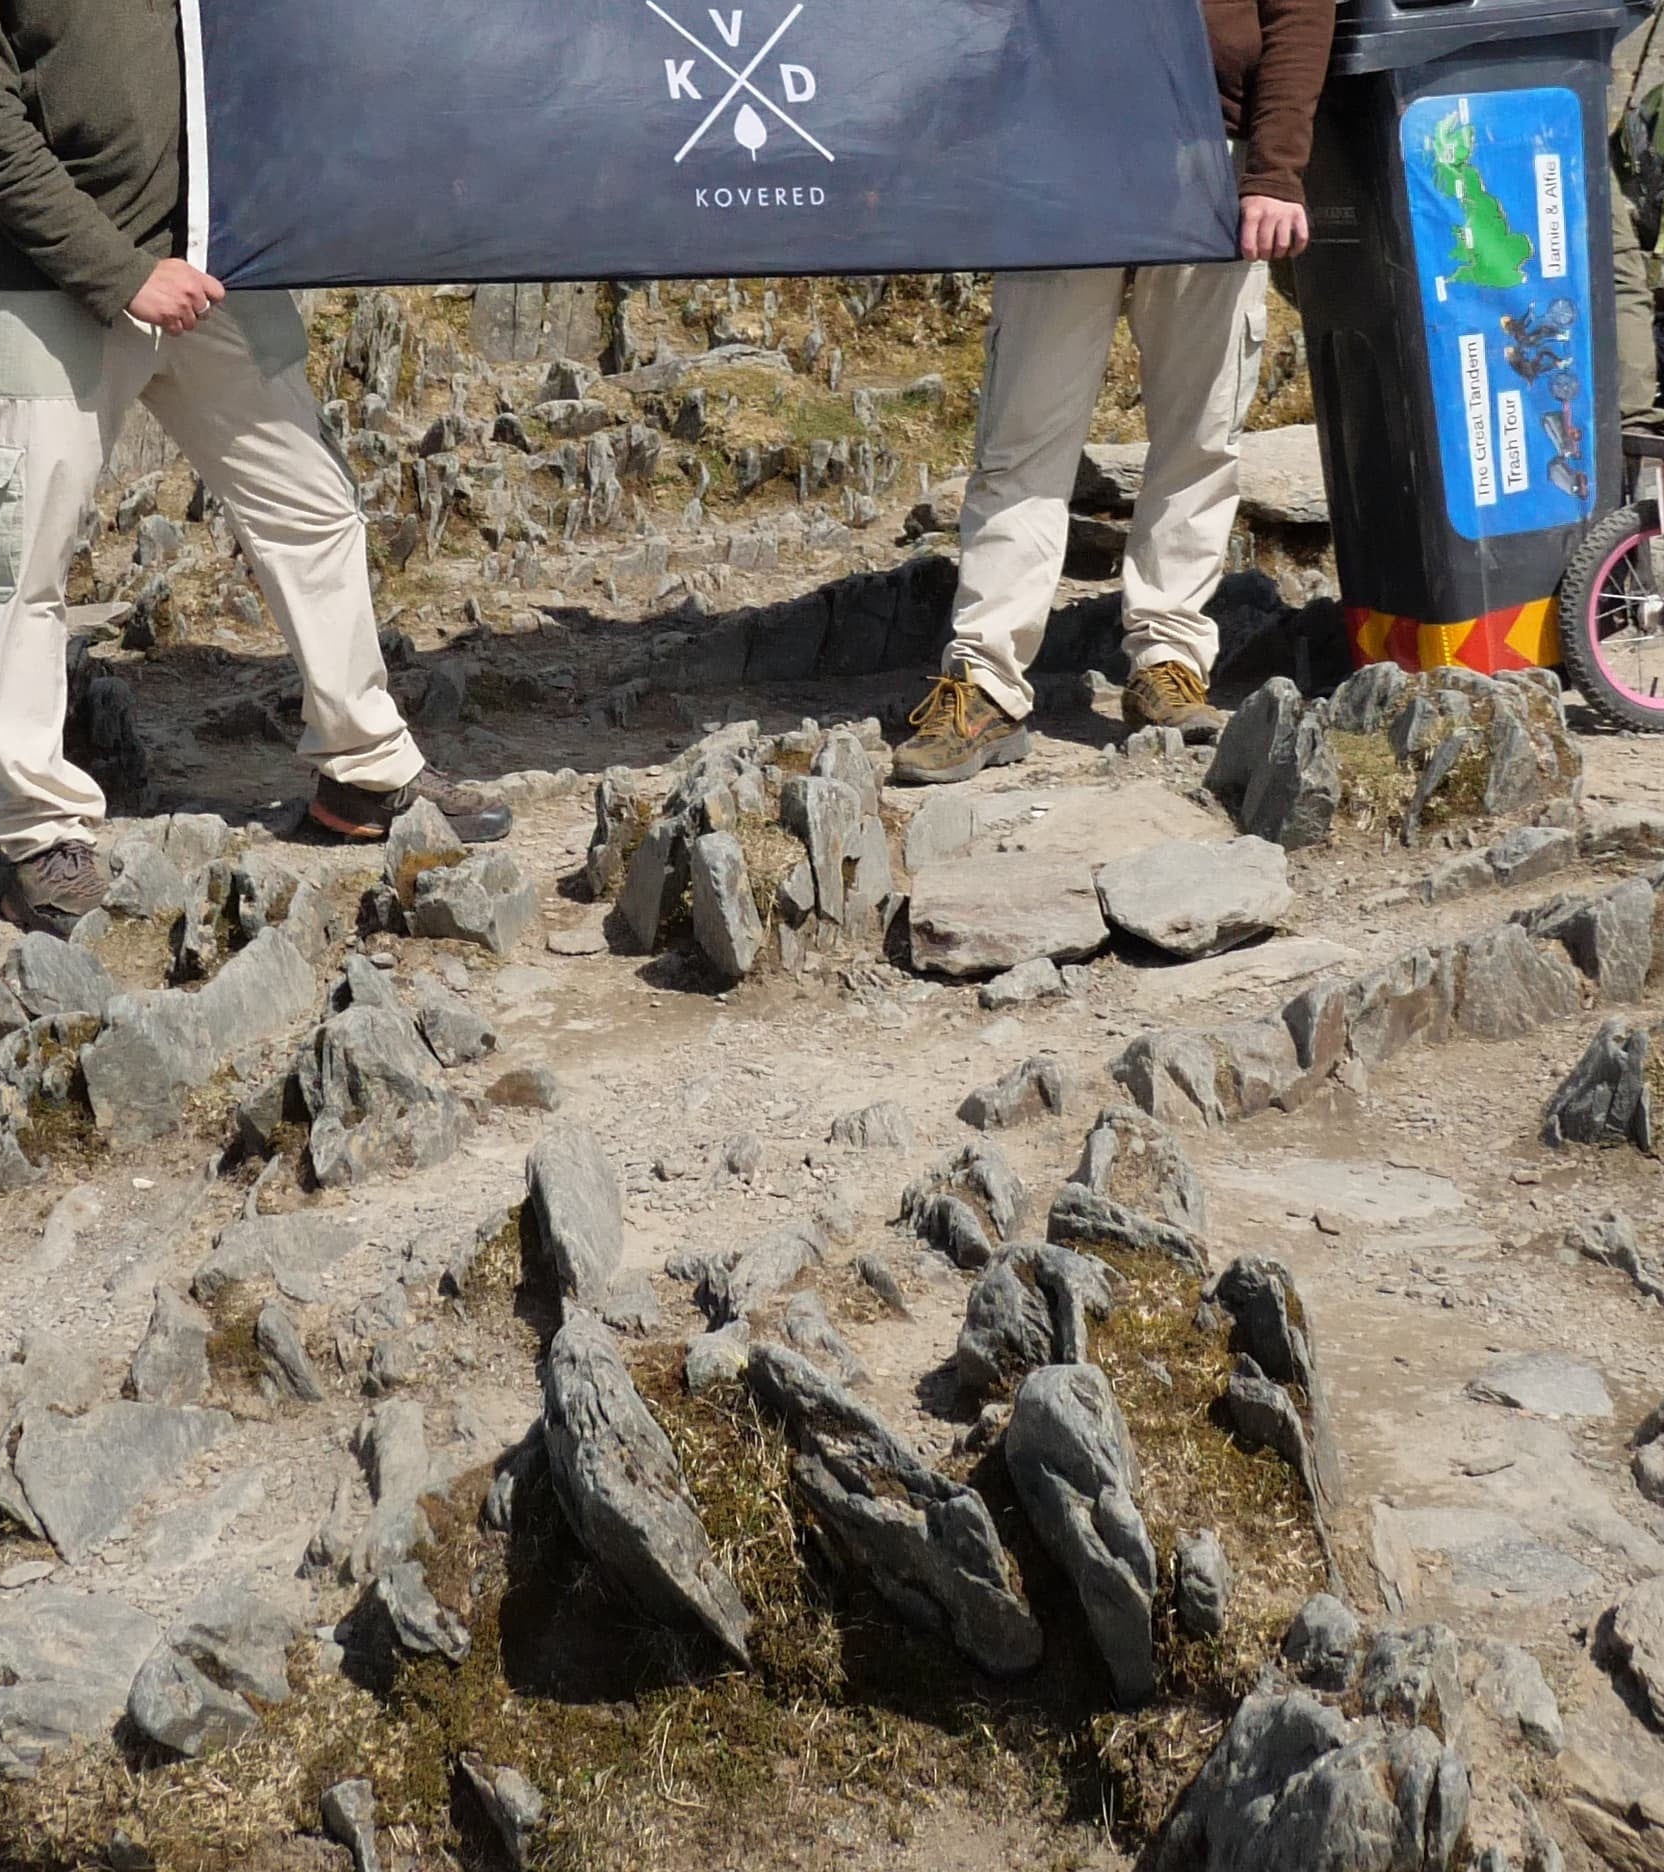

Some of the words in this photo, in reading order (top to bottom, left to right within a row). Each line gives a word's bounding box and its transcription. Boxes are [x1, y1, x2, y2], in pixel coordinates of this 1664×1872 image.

[707, 8, 743, 48] V
[664, 58, 703, 100] K
[779, 63, 816, 103] D
[695, 186, 825, 208] KOVERED
[1543, 161, 1558, 198] Alfie
[1545, 204, 1558, 215] &
[1547, 221, 1561, 272] Jamie
[1465, 341, 1482, 410] Tandem
[1503, 398, 1518, 436] Tour
[1471, 414, 1487, 461] Great
[1477, 465, 1489, 496] The
[1505, 439, 1523, 487] Trash
